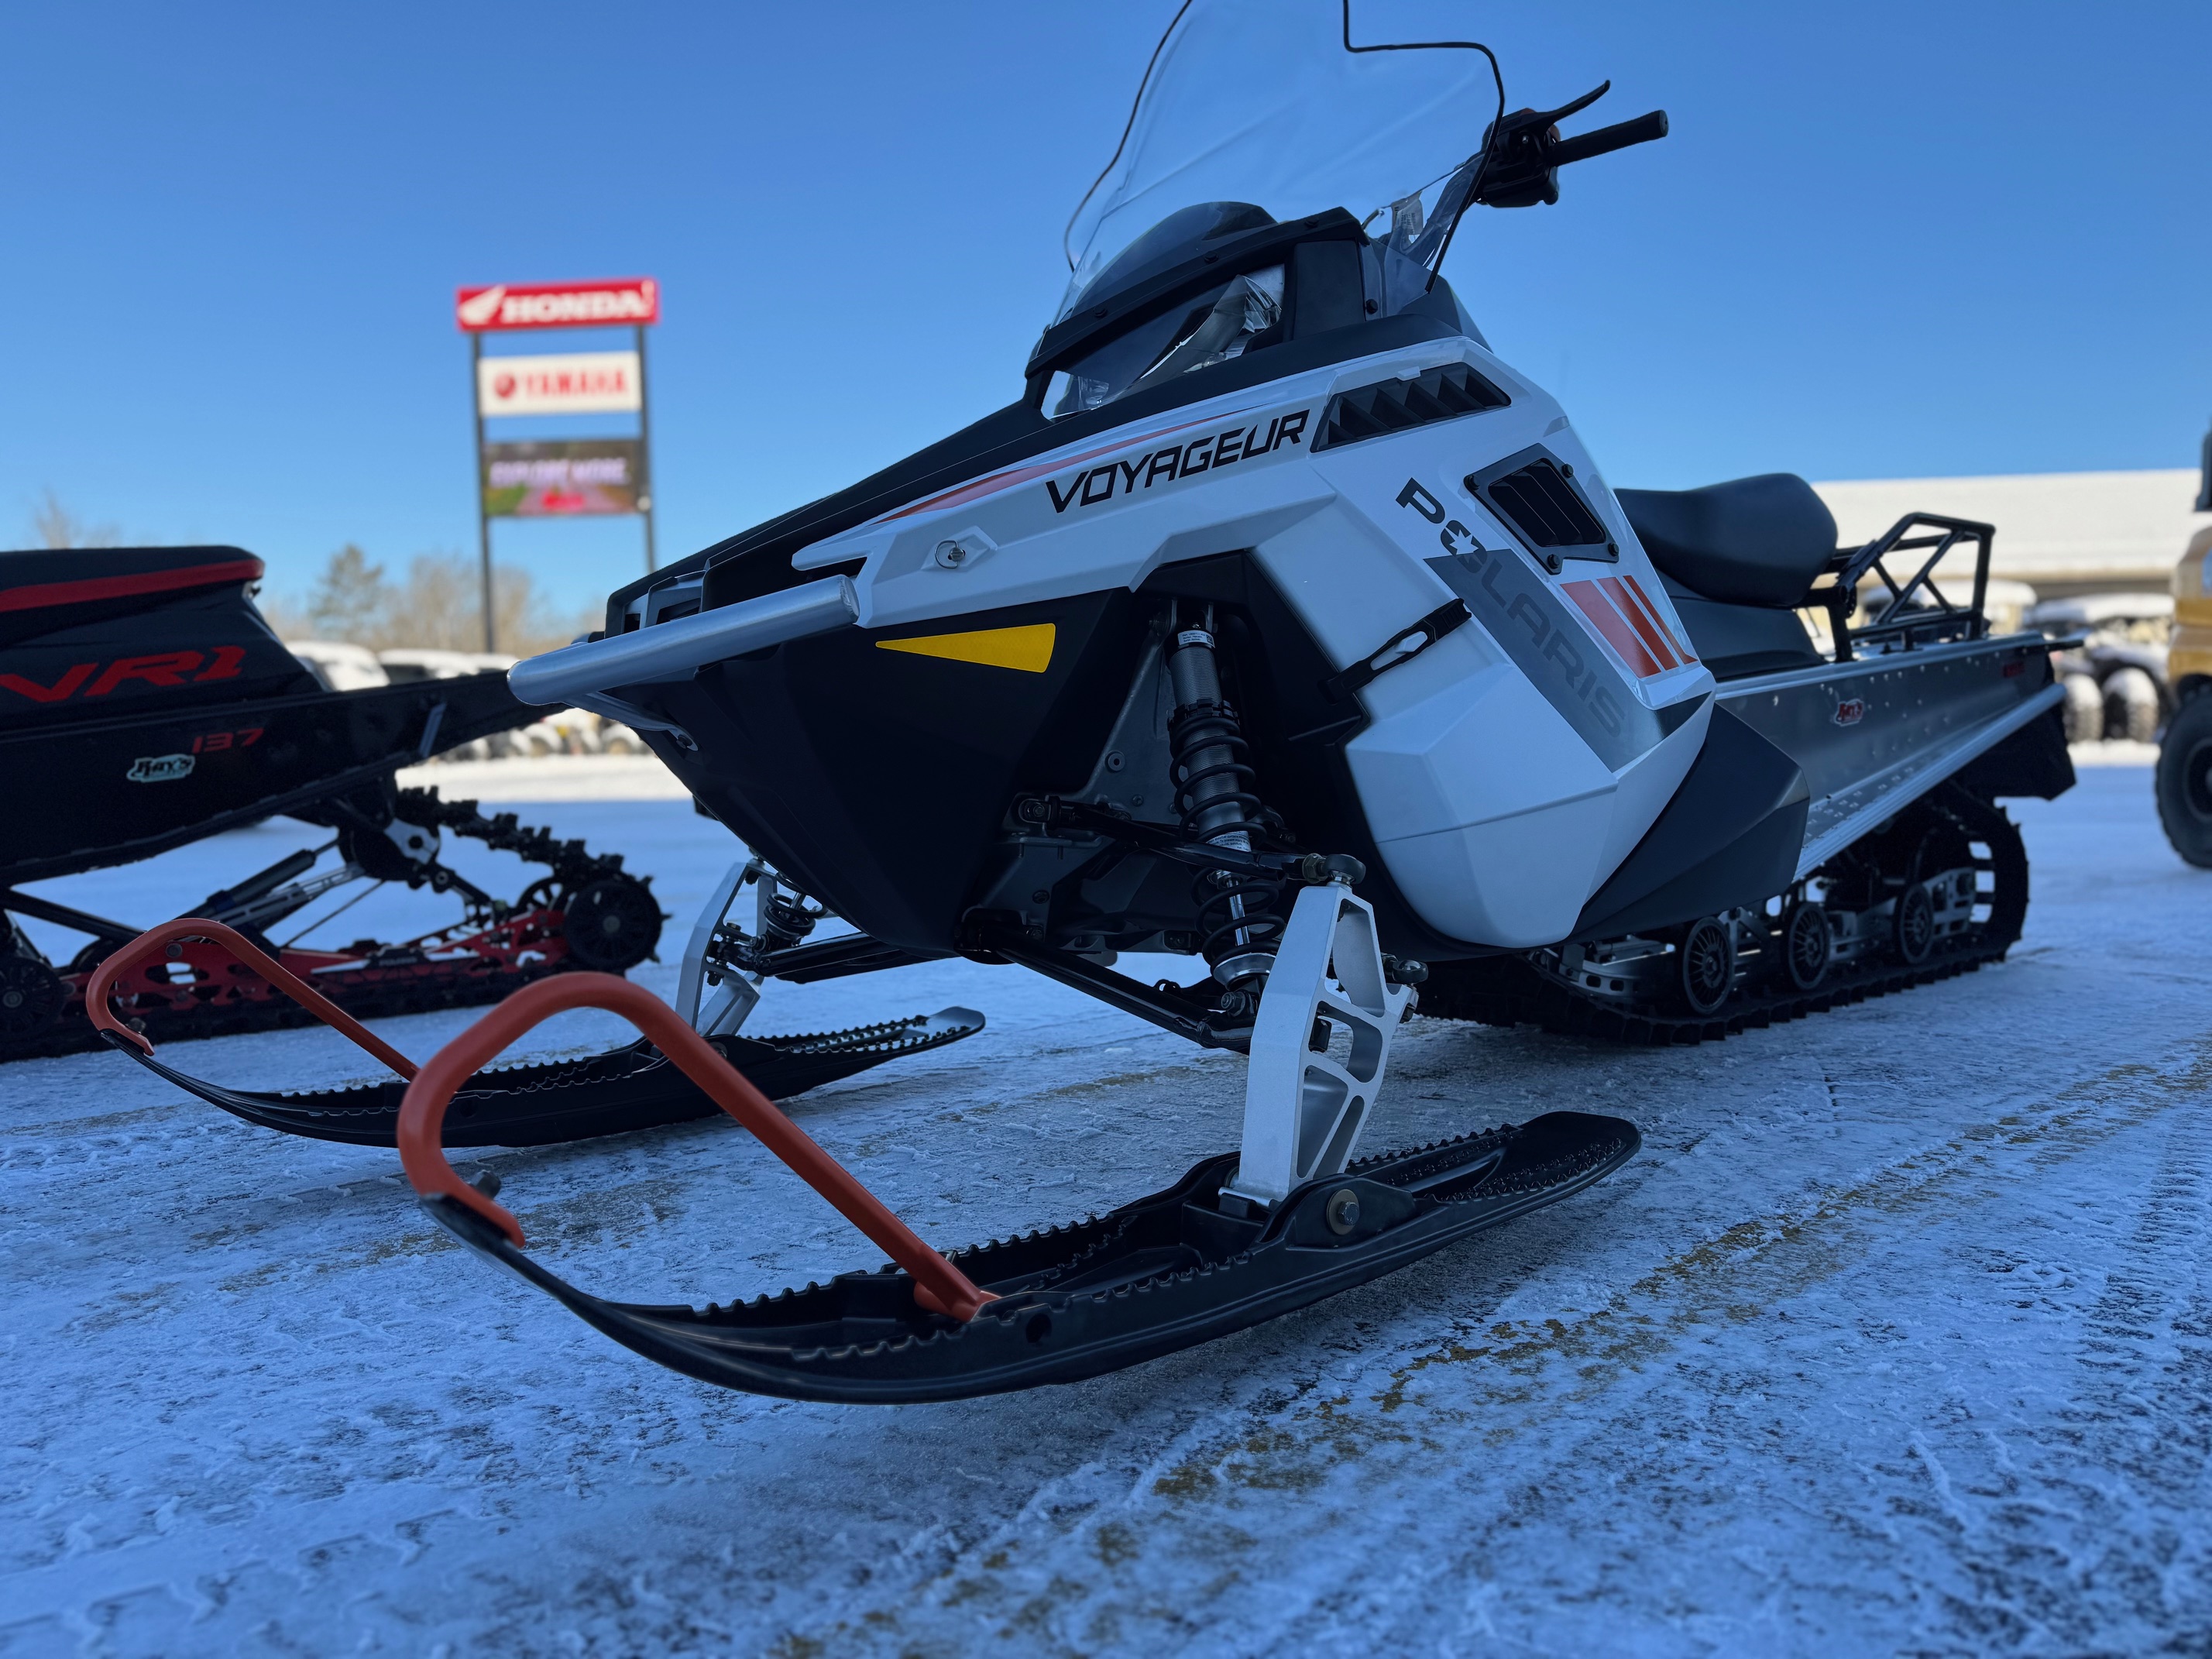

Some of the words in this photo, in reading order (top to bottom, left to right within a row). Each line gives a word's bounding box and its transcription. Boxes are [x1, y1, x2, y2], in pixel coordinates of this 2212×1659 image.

[1046, 409, 1310, 514] VOYAGEUR
[1396, 477, 1626, 737] POLARIS
[0, 645, 246, 702] VR1
[192, 728, 264, 754] 137
